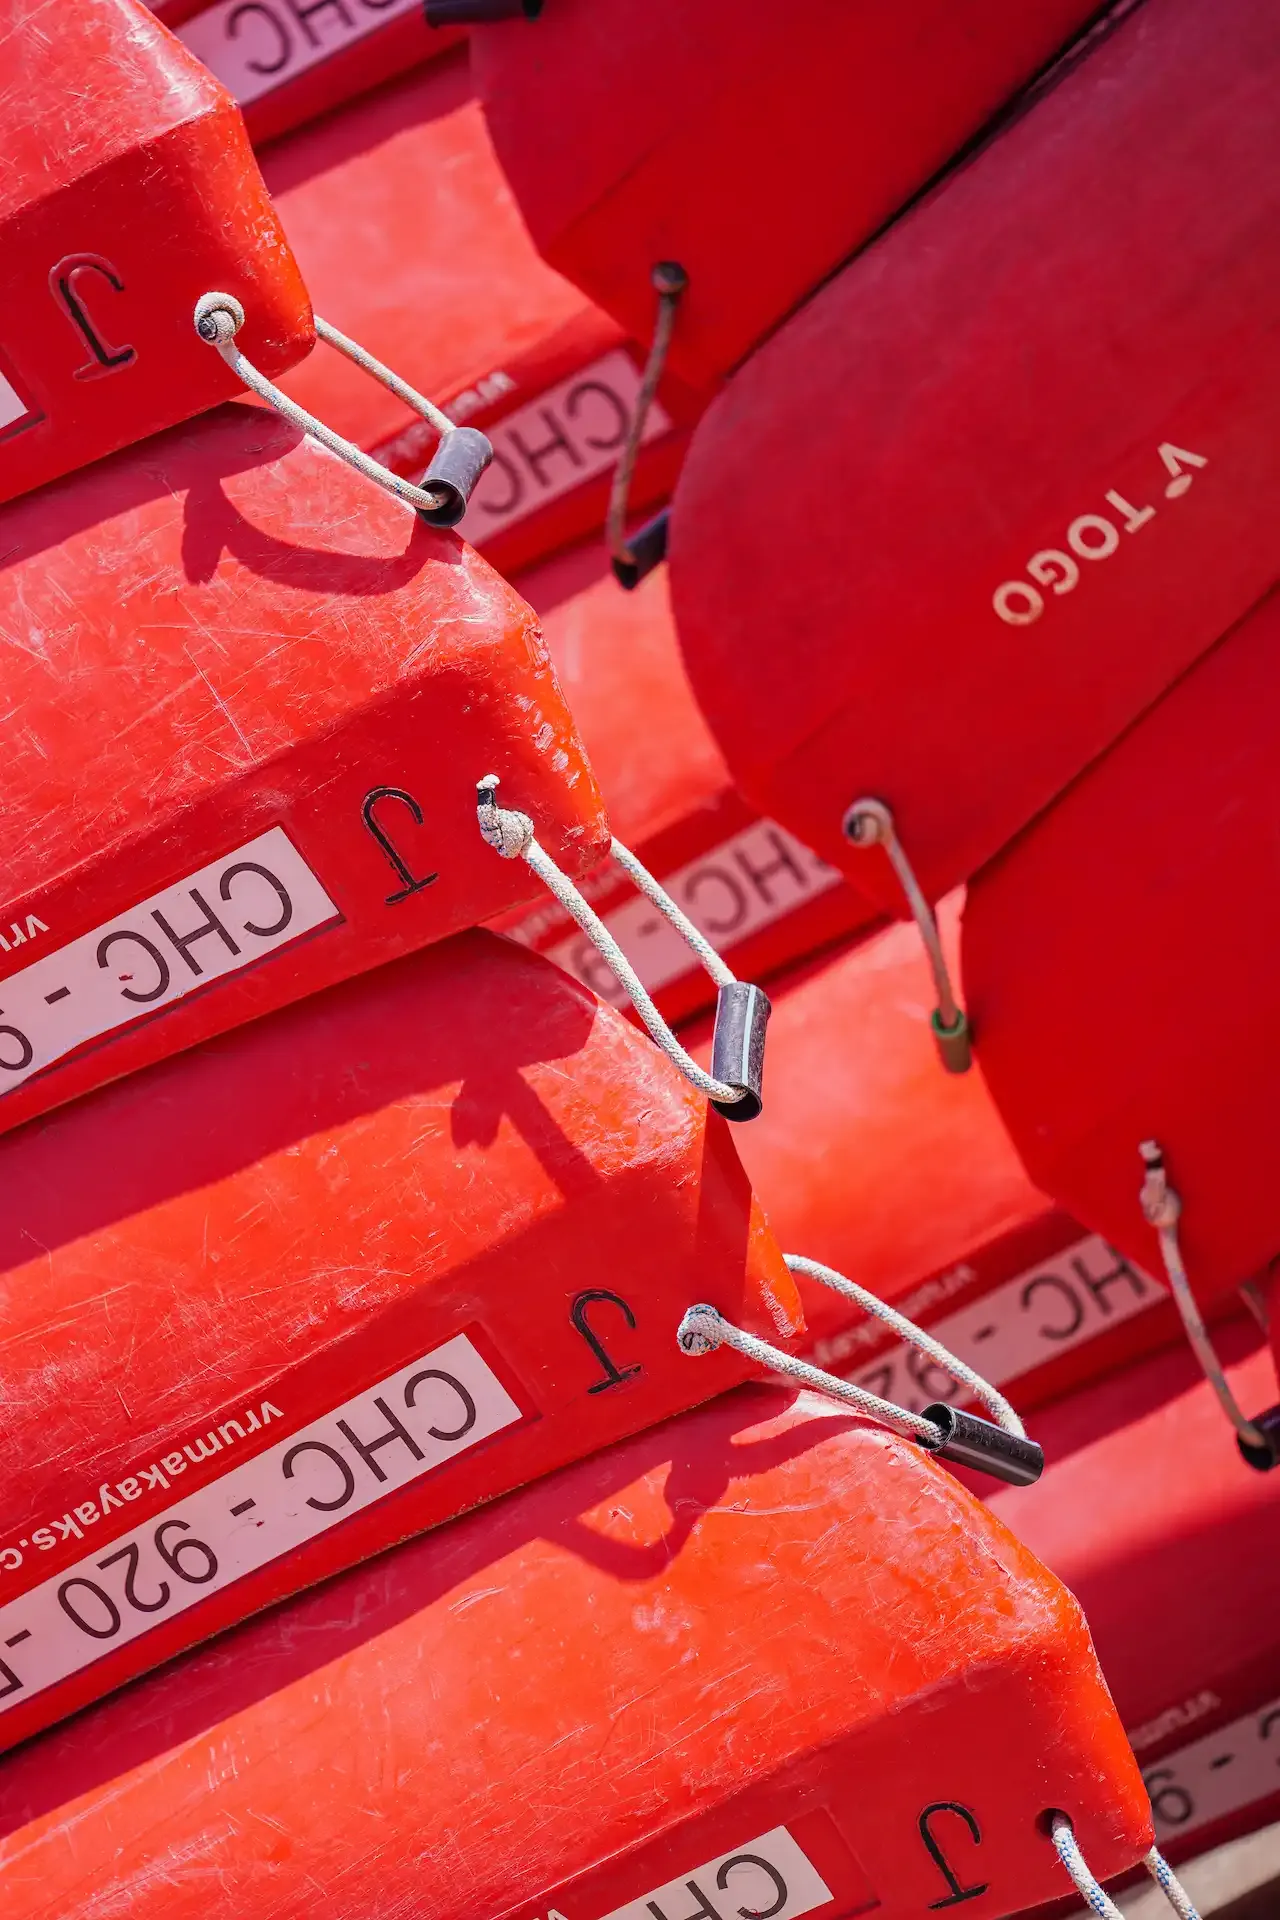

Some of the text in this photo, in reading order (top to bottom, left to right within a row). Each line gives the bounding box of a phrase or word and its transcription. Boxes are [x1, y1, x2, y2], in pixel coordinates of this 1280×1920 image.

[226, 0, 395, 73] HC
[48, 252, 138, 382] J
[992, 489, 1156, 626] TOGO
[361, 785, 440, 905] J
[683, 828, 826, 933] HC
[96, 862, 293, 1004] CHC
[570, 1288, 643, 1395] J
[282, 1369, 477, 1512] CHC
[57, 1519, 218, 1639] 920
[916, 1801, 989, 1910] J
